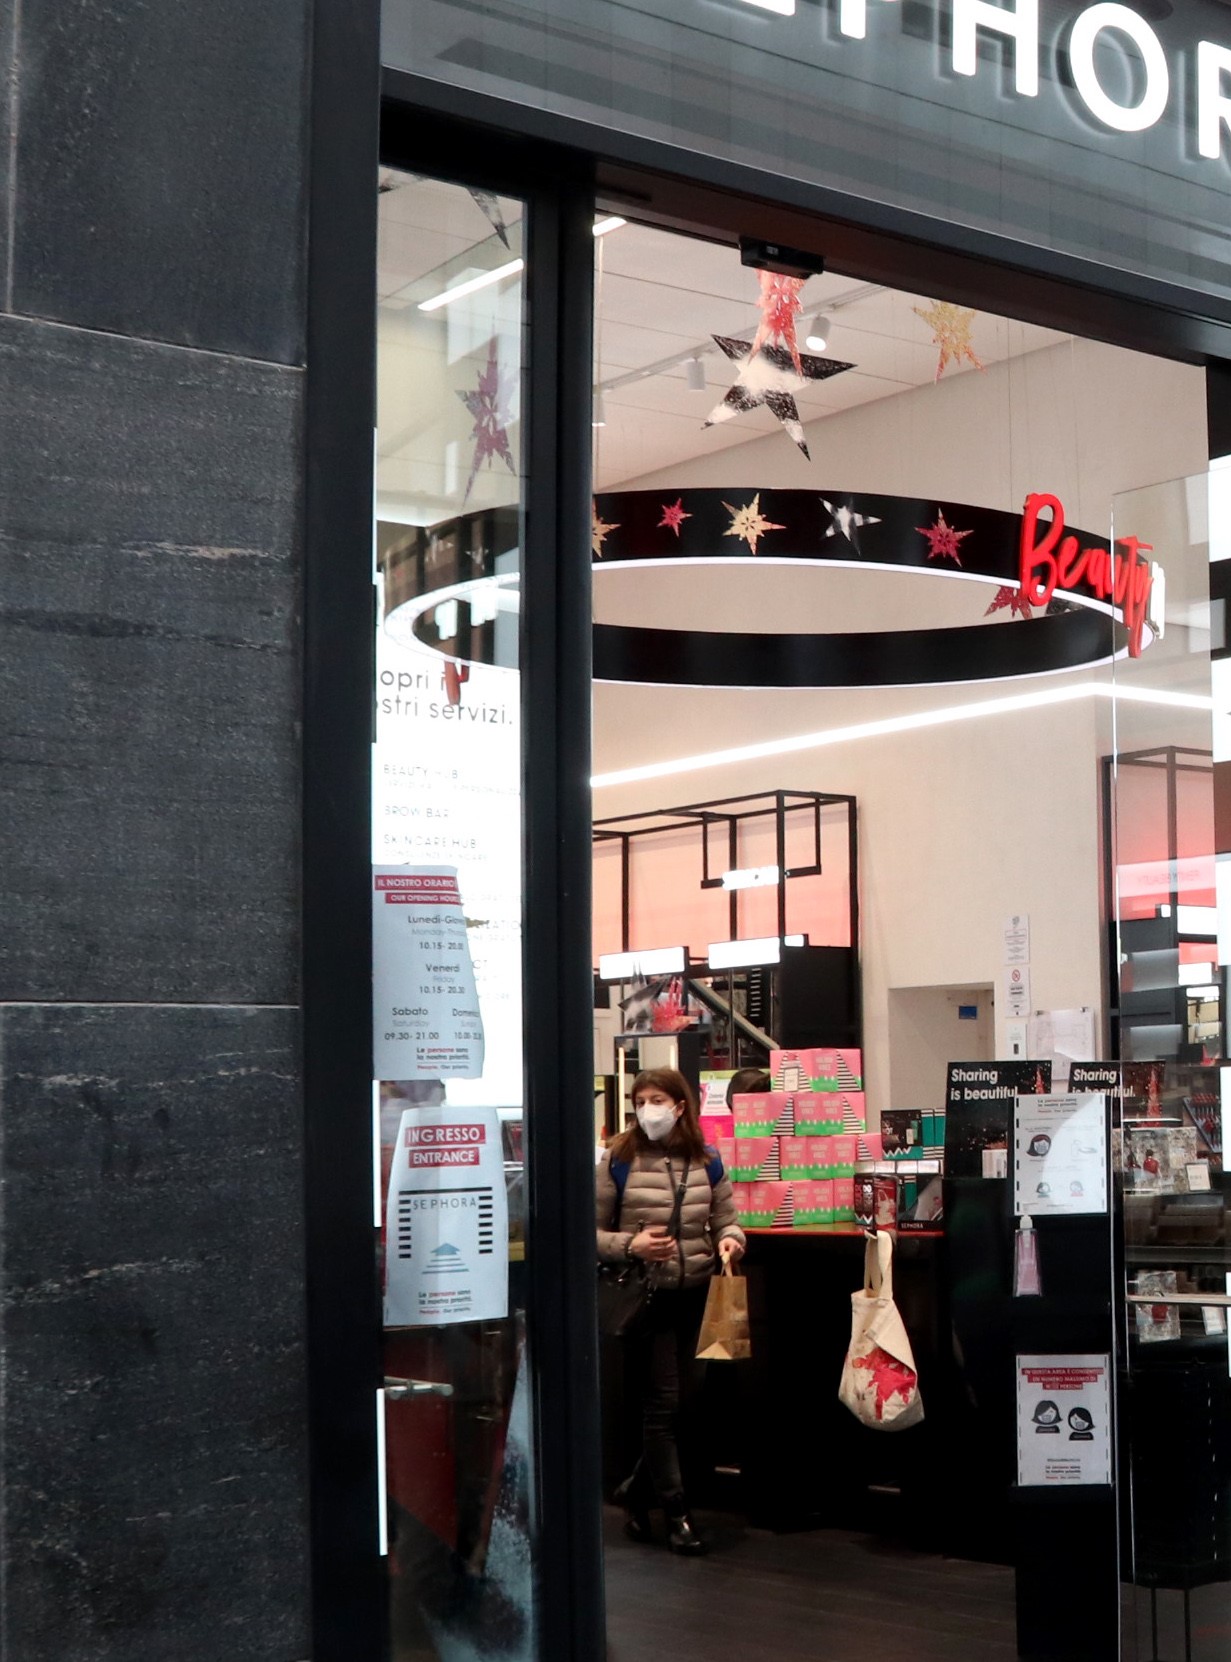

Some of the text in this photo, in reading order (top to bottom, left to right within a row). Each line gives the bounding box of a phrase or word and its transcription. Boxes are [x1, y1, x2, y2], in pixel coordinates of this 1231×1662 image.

[380, 670, 428, 692] opri
[380, 694, 513, 725] stri servizi.
[377, 879, 455, 887] IL NOSTRO ORARIO
[392, 1007, 429, 1016] Sabato
[951, 1068, 998, 1084] Sharing
[1073, 1068, 1117, 1083] Sharing
[950, 1088, 961, 1100] is
[408, 1127, 480, 1143] INGRESSO
[413, 1150, 475, 1164] ENTRANCE
[413, 1198, 477, 1210] SEPHORA
